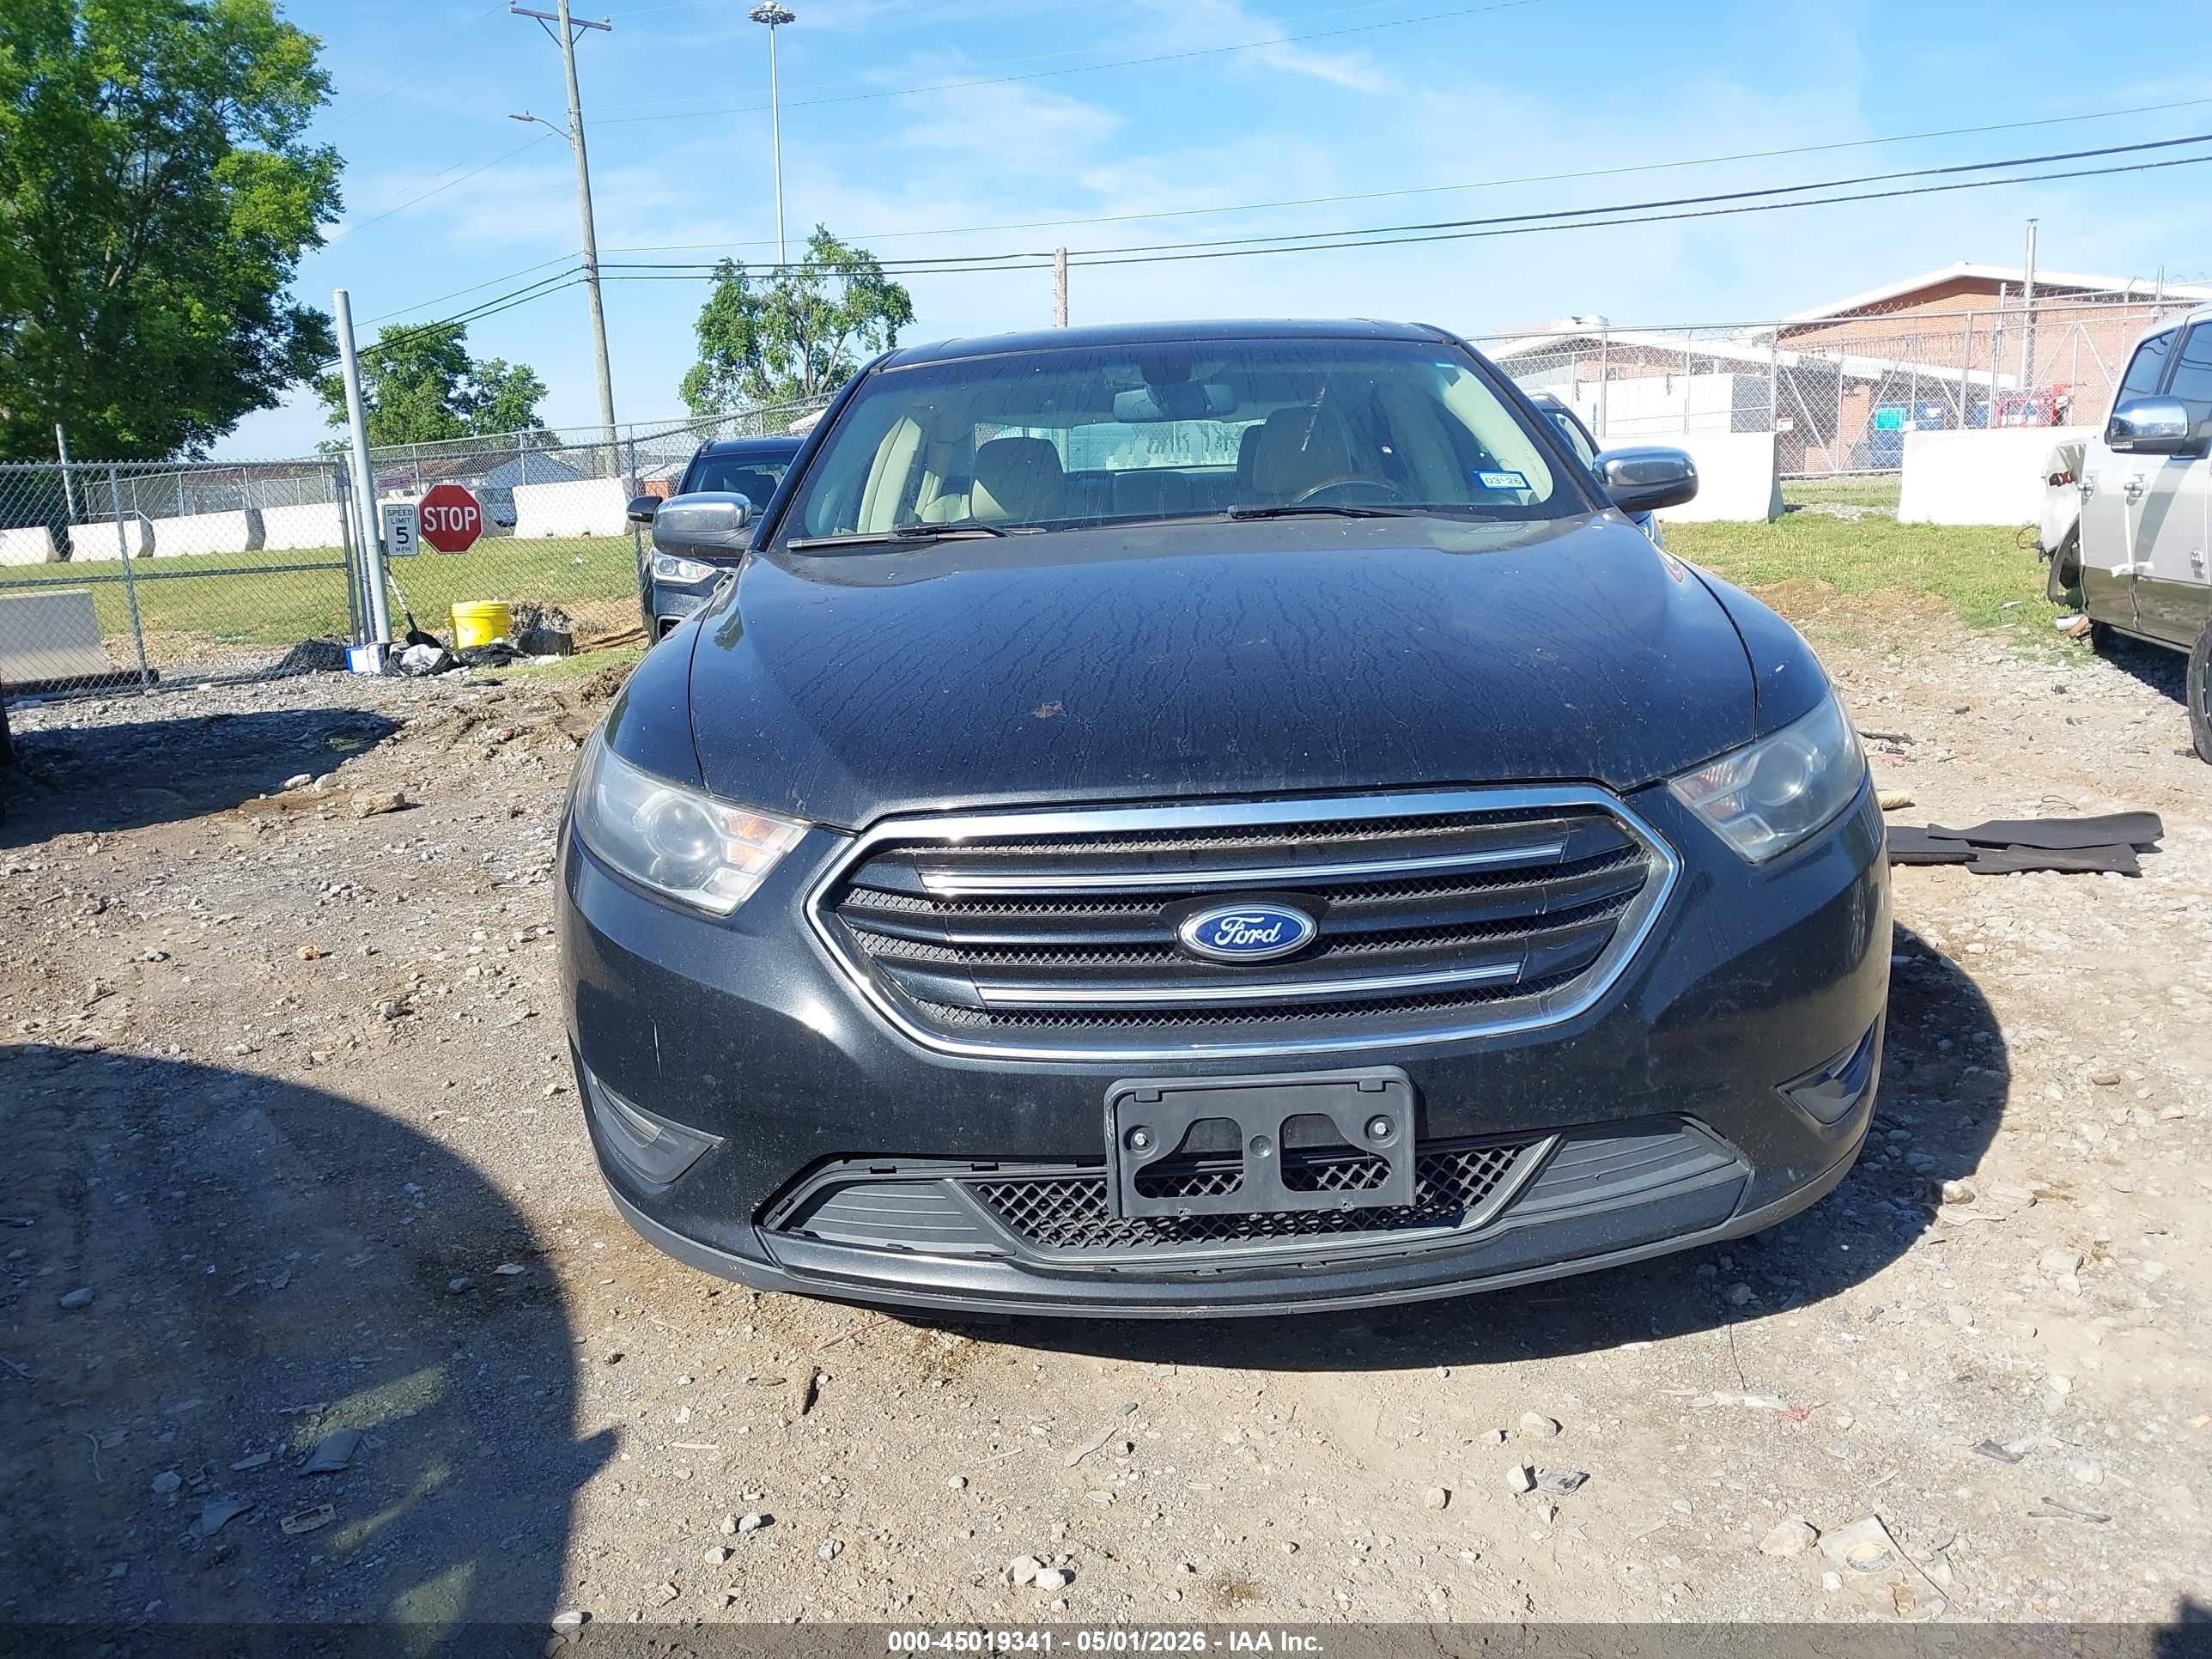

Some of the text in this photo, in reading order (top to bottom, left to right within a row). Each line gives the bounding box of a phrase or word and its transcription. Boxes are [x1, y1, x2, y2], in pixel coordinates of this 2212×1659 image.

[423, 506, 477, 532] STOP
[396, 526, 410, 544] 5
[1214, 916, 1283, 945] Ford
